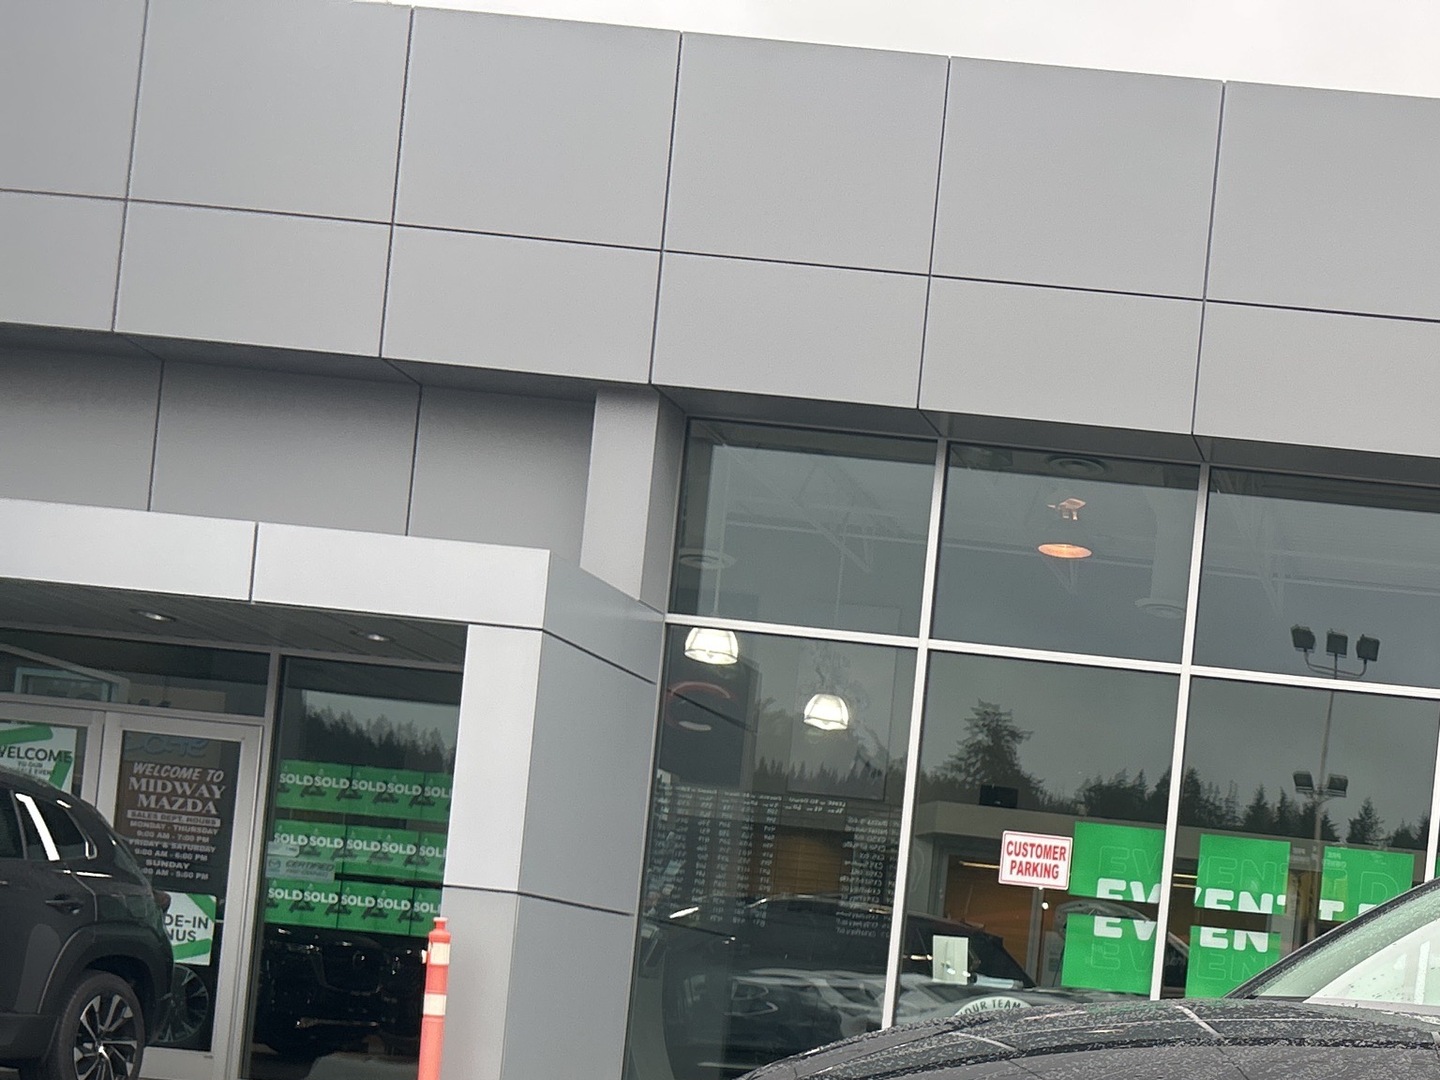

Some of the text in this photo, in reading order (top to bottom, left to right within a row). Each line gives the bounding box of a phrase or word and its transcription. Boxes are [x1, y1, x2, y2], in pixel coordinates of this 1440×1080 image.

[133, 762, 224, 782] WELCOME TO
[129, 776, 226, 799] MIDWAY
[280, 773, 452, 798] SOLD SOLD SOLD SOLD SOL
[137, 794, 218, 815] MAZDA
[131, 811, 158, 819] SALES
[187, 817, 217, 825] HOURS
[130, 820, 166, 830] MONDAY
[173, 824, 220, 835] THURSDAY
[157, 831, 170, 840] AM
[197, 835, 210, 843] PM
[274, 833, 447, 858] SOLD SOLD SOLD SOLD SOL
[129, 839, 160, 848] FRIDAY
[171, 842, 217, 853] SATURDAY
[1006, 840, 1066, 862] CUSTOMER
[155, 849, 168, 858] AM
[194, 853, 208, 861] PM
[145, 859, 191, 869] SUNDAY
[1009, 860, 1059, 880] PARKING
[155, 868, 169, 877] AM
[195, 872, 209, 880] PM
[268, 888, 441, 914] SOLD SOLD SOLD SOLD SOL
[961, 999, 1021, 1014] OUR TEAM
